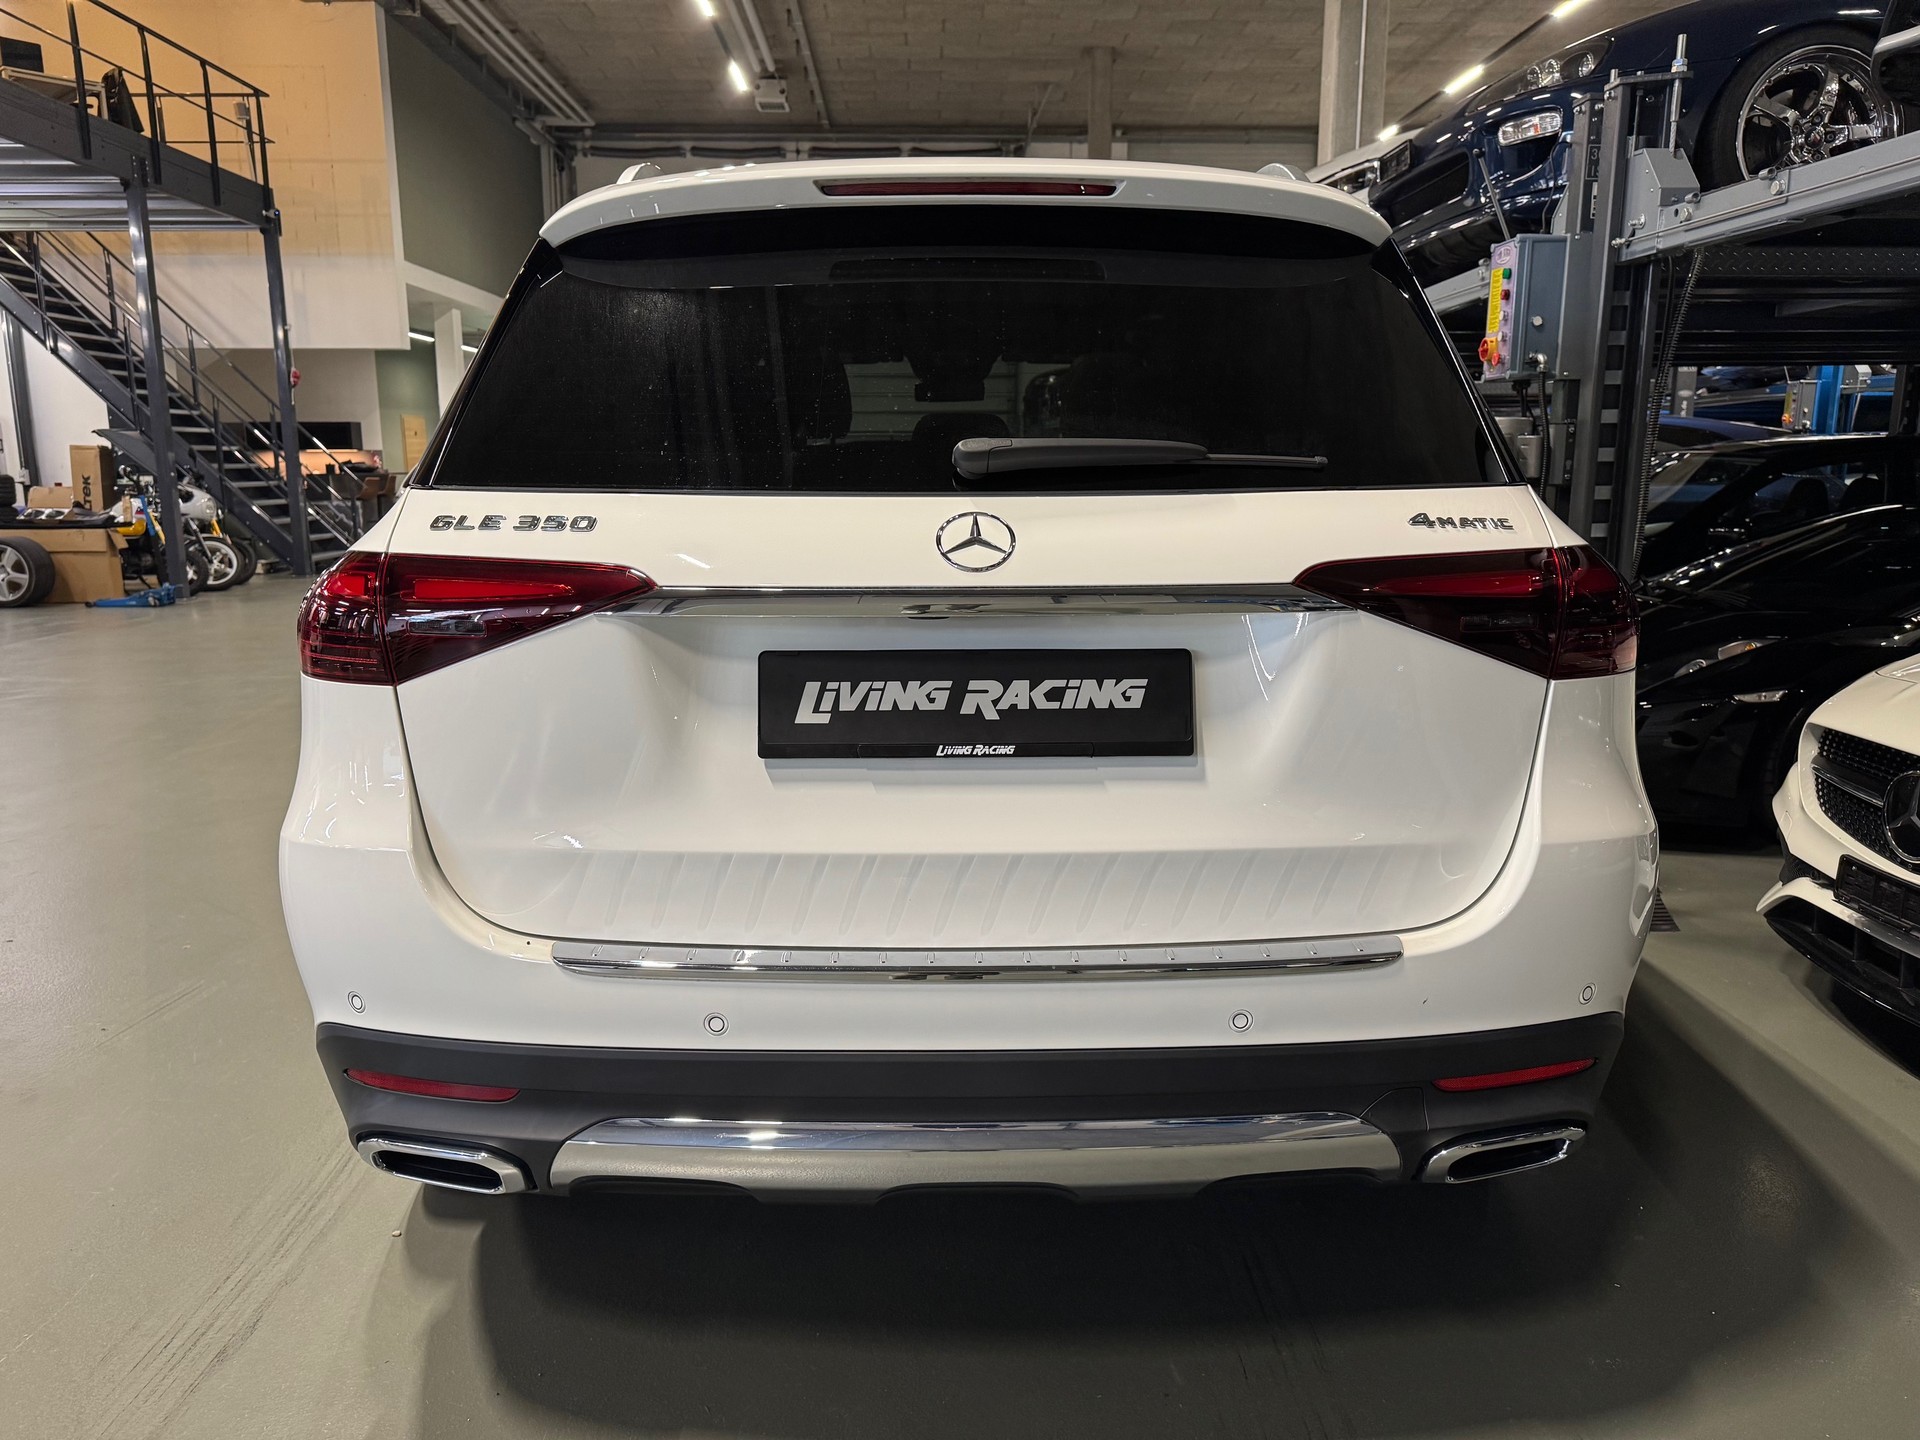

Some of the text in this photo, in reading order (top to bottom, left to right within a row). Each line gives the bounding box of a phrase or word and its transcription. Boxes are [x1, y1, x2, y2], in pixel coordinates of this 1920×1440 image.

[429, 514, 599, 532] GLE 350
[1408, 512, 1515, 530] 4MATIC
